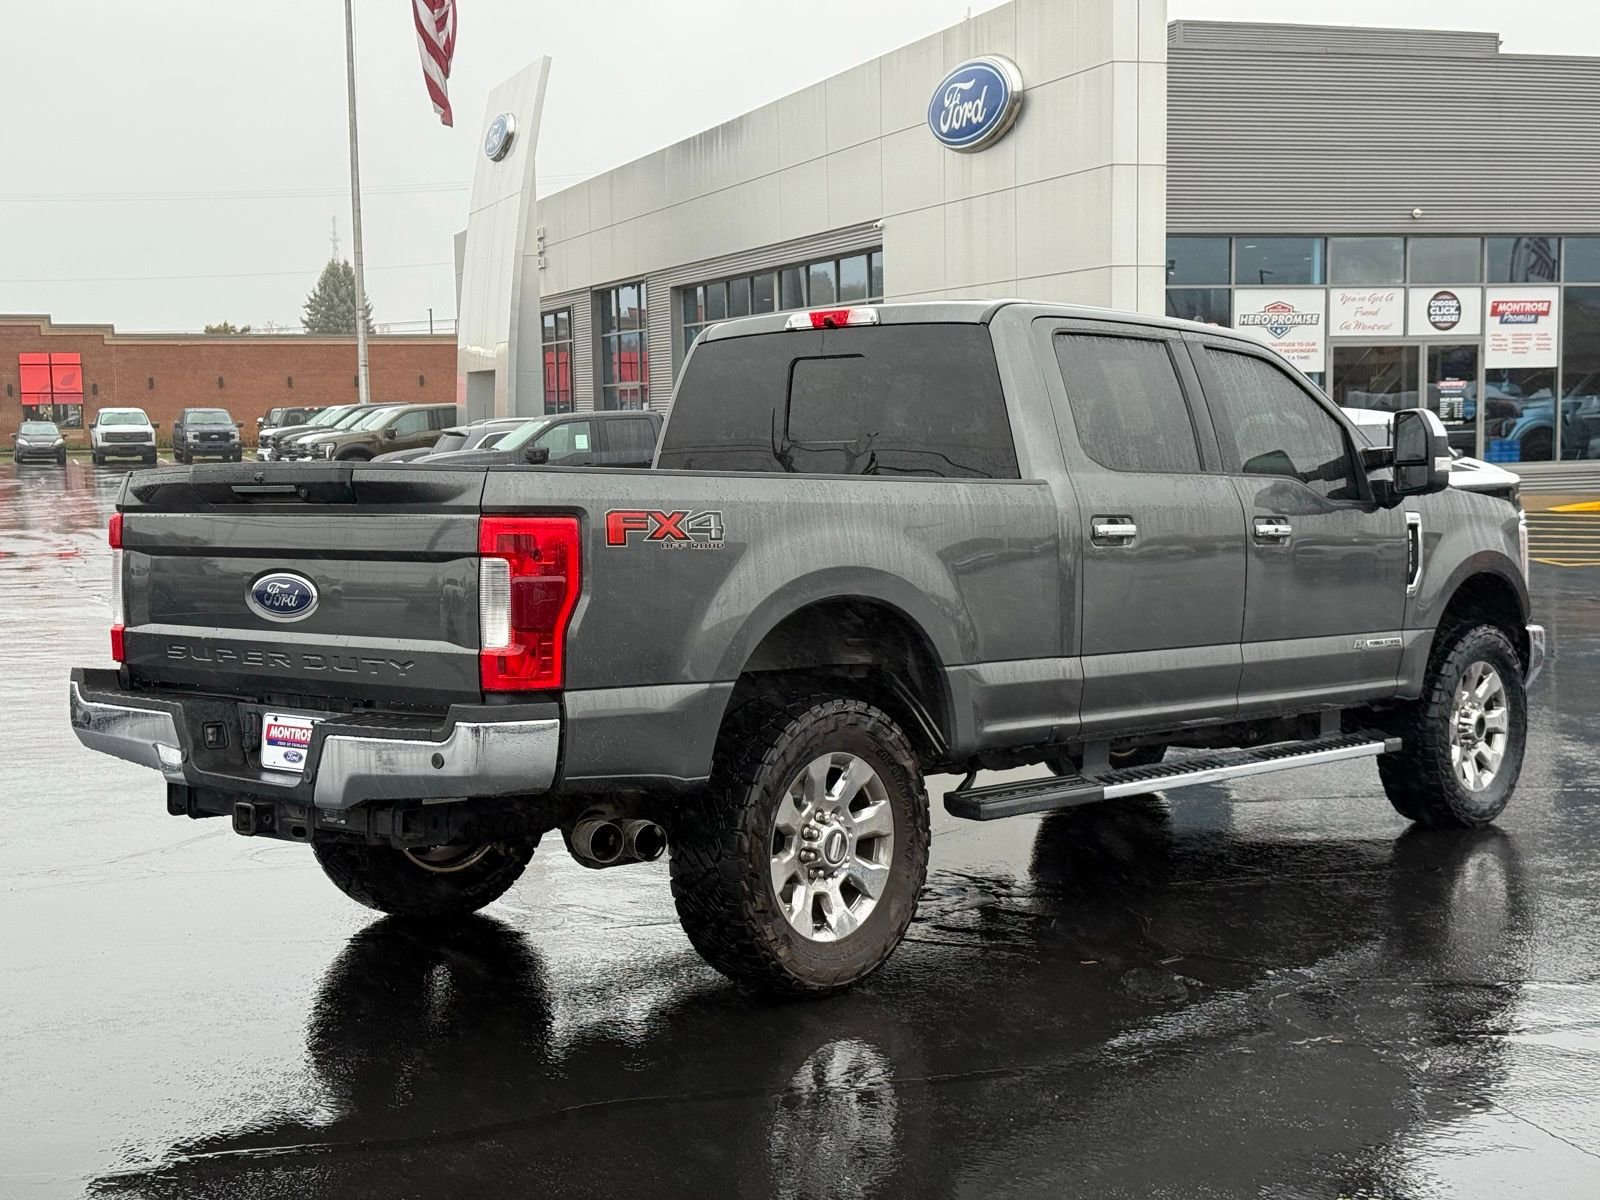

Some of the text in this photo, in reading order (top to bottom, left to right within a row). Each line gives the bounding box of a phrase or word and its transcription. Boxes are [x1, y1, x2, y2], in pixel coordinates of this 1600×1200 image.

[940, 78, 988, 134] Ford
[1496, 302, 1550, 313] MONTROSE
[604, 508, 725, 548] FX4
[661, 541, 725, 550] OFF ROAD
[263, 581, 299, 608] Ford
[167, 645, 415, 677] SUPER DUTY
[269, 725, 313, 742] MONTROS
[286, 751, 300, 762] Ford
